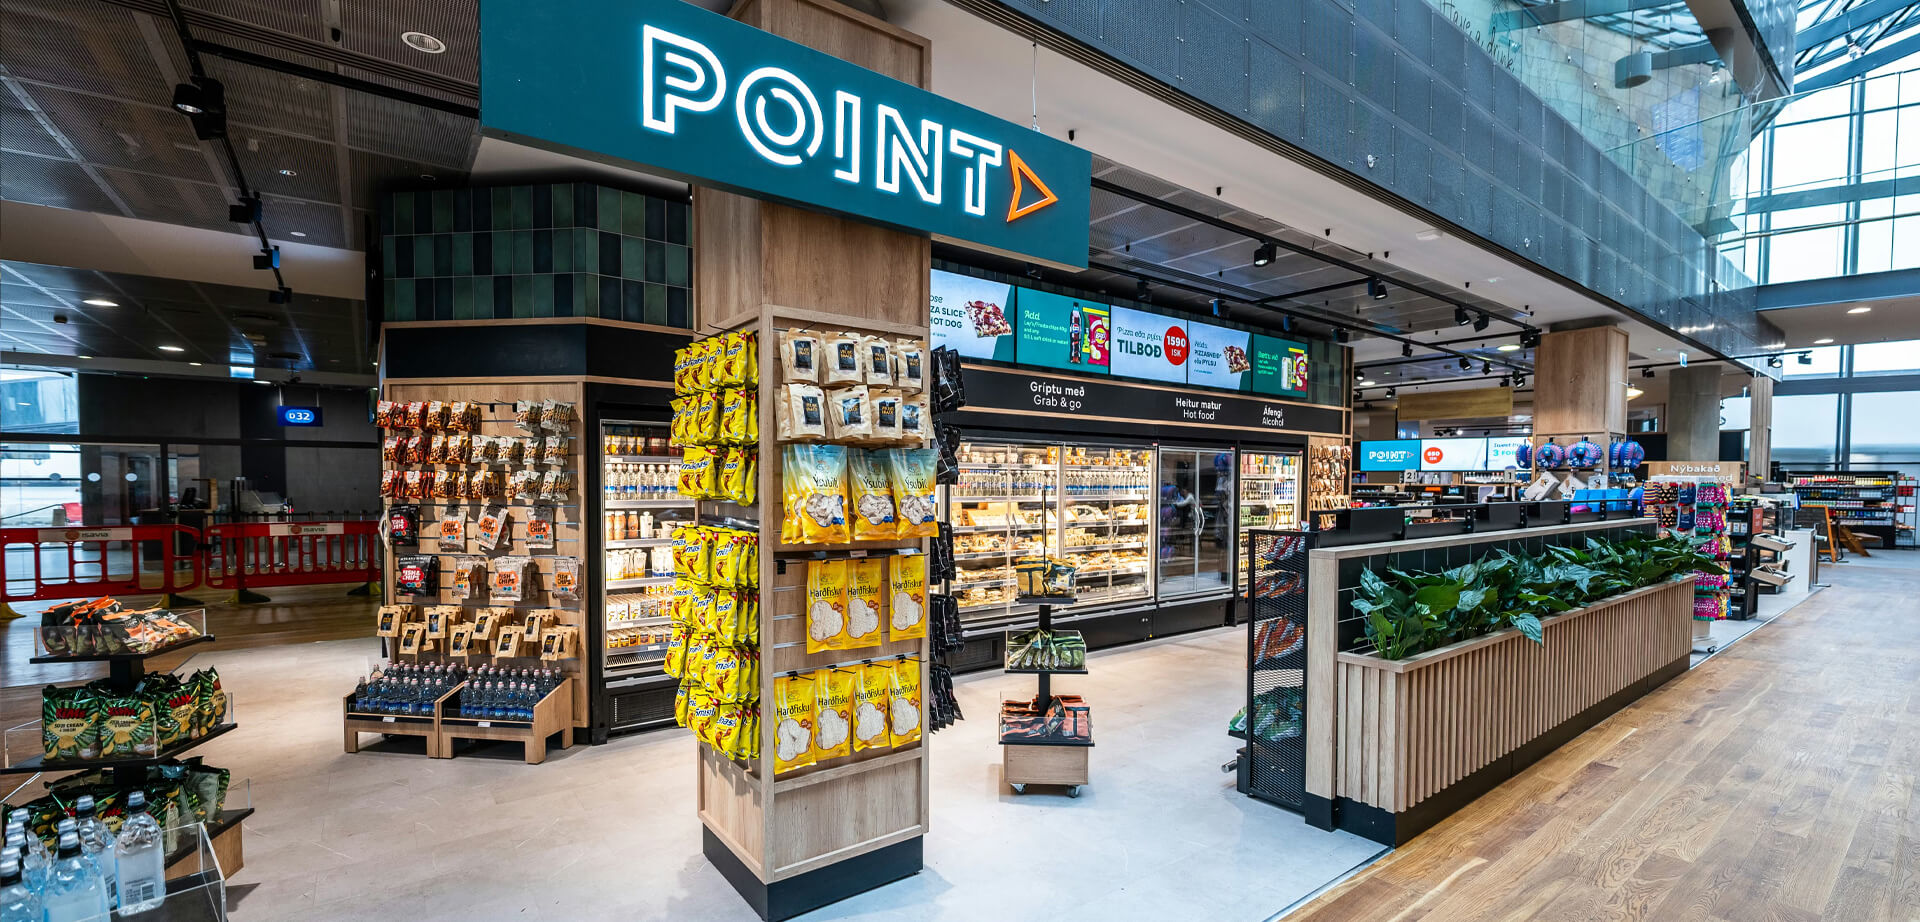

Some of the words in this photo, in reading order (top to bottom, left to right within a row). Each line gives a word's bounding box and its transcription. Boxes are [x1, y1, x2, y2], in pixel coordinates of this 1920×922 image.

[643, 24, 1003, 216] POINT
[1024, 310, 1040, 320] Add
[945, 319, 963, 329] DOG
[1167, 335, 1186, 348] 1590
[1117, 339, 1162, 358] TILBOÐ
[1172, 348, 1182, 357] ISK
[1064, 386, 1085, 397] með
[1033, 394, 1058, 407] Grab
[1060, 396, 1068, 407] &
[1069, 400, 1082, 411] go
[1175, 397, 1199, 410] Heitur
[1201, 401, 1222, 411] matur
[1183, 409, 1198, 419] Hot
[1199, 411, 1215, 421] food
[1263, 404, 1283, 418] Áfengi
[1262, 417, 1284, 427] Alcohol
[1369, 450, 1407, 460] POINT
[1493, 449, 1499, 457] 3
[1670, 464, 1721, 474] Nýbakað
